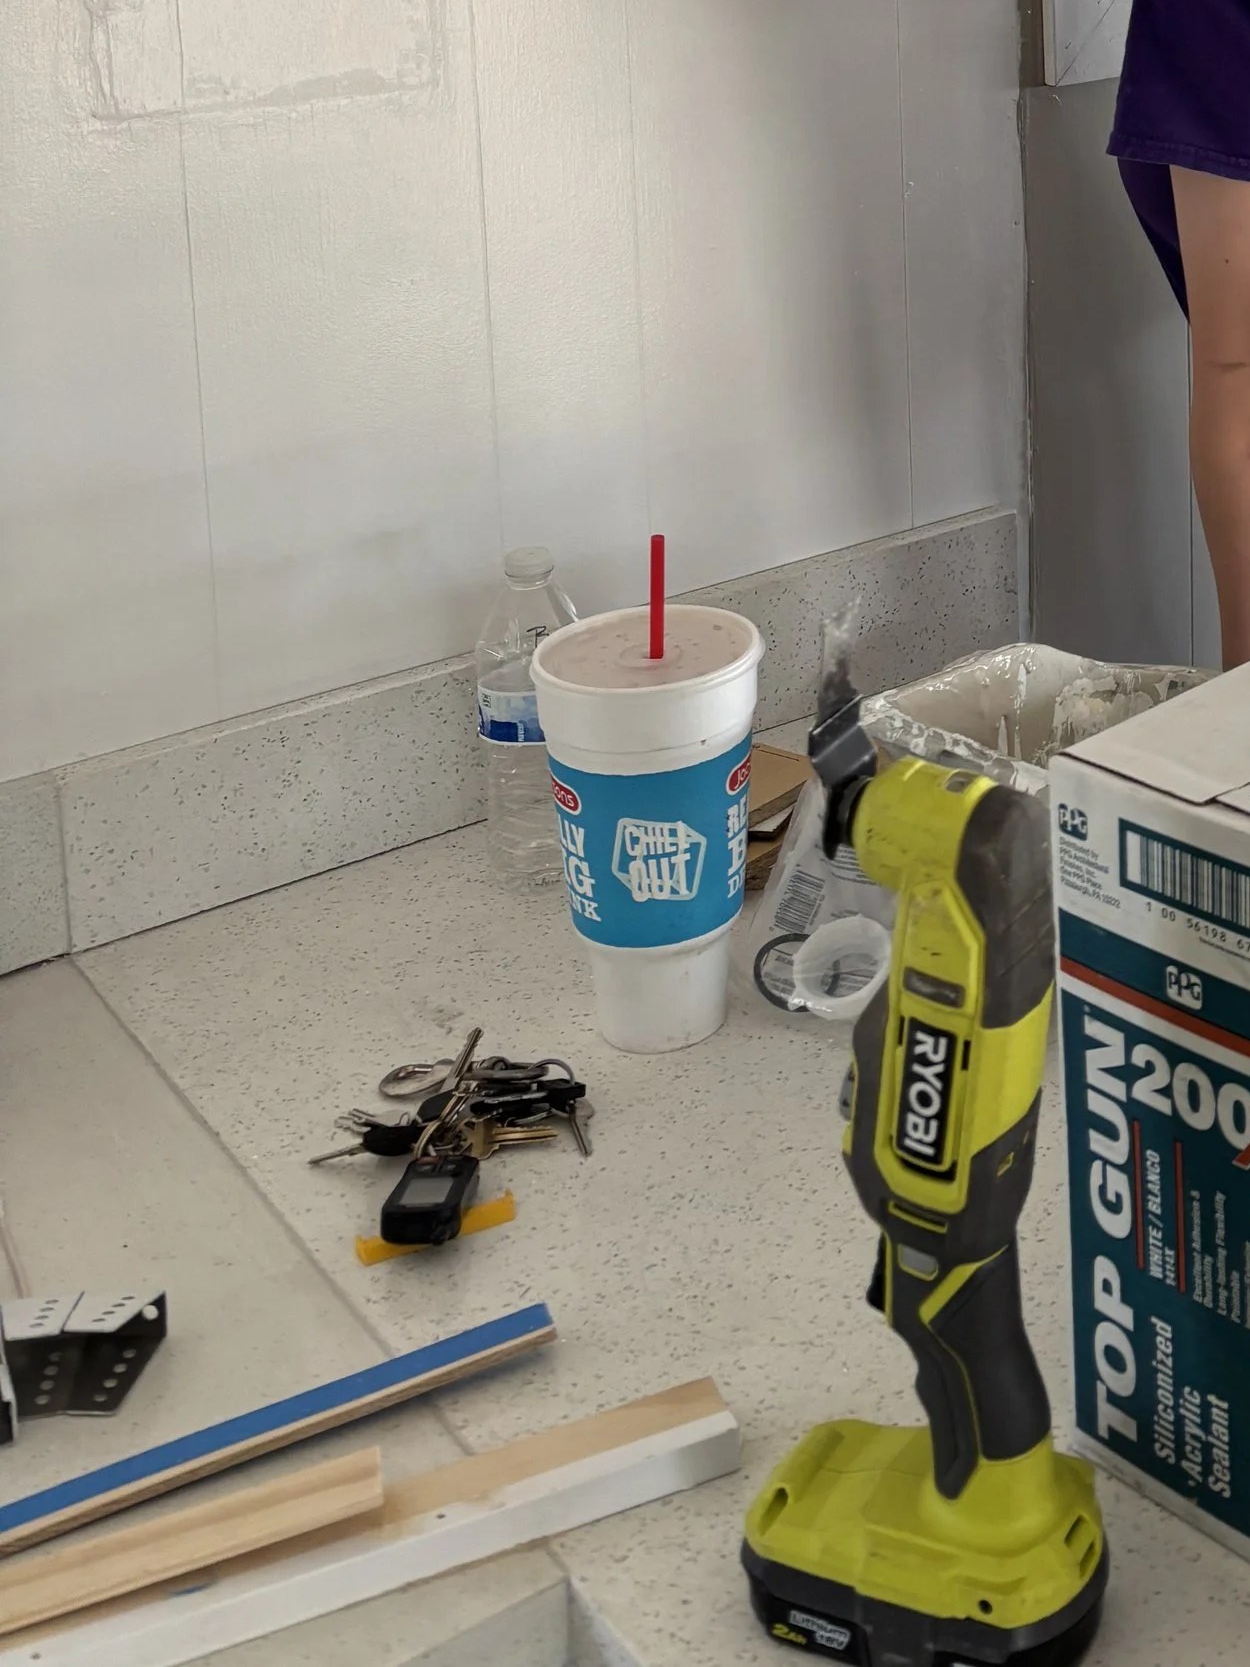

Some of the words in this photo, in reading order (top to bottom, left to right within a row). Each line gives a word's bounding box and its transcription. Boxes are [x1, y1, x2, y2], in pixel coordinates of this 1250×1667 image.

[551, 784, 574, 809] ons
[1059, 806, 1087, 837] PPG
[628, 853, 691, 902] OUT
[1146, 901, 1152, 912] 1
[1161, 907, 1175, 922] 00
[1186, 917, 1227, 943] 56198
[1167, 969, 1201, 1002] PPG
[903, 1030, 948, 1156] RYOBI
[1084, 1014, 1133, 1239] GUN
[1146, 1149, 1161, 1215] BLANCO
[1148, 1225, 1163, 1279] WHITE
[1094, 1255, 1138, 1443] TOP
[1150, 1315, 1176, 1465] Siliconized
[1179, 1385, 1206, 1484] Acrylic
[1207, 1394, 1231, 1499] Sealant
[791, 1610, 850, 1638] Lithium
